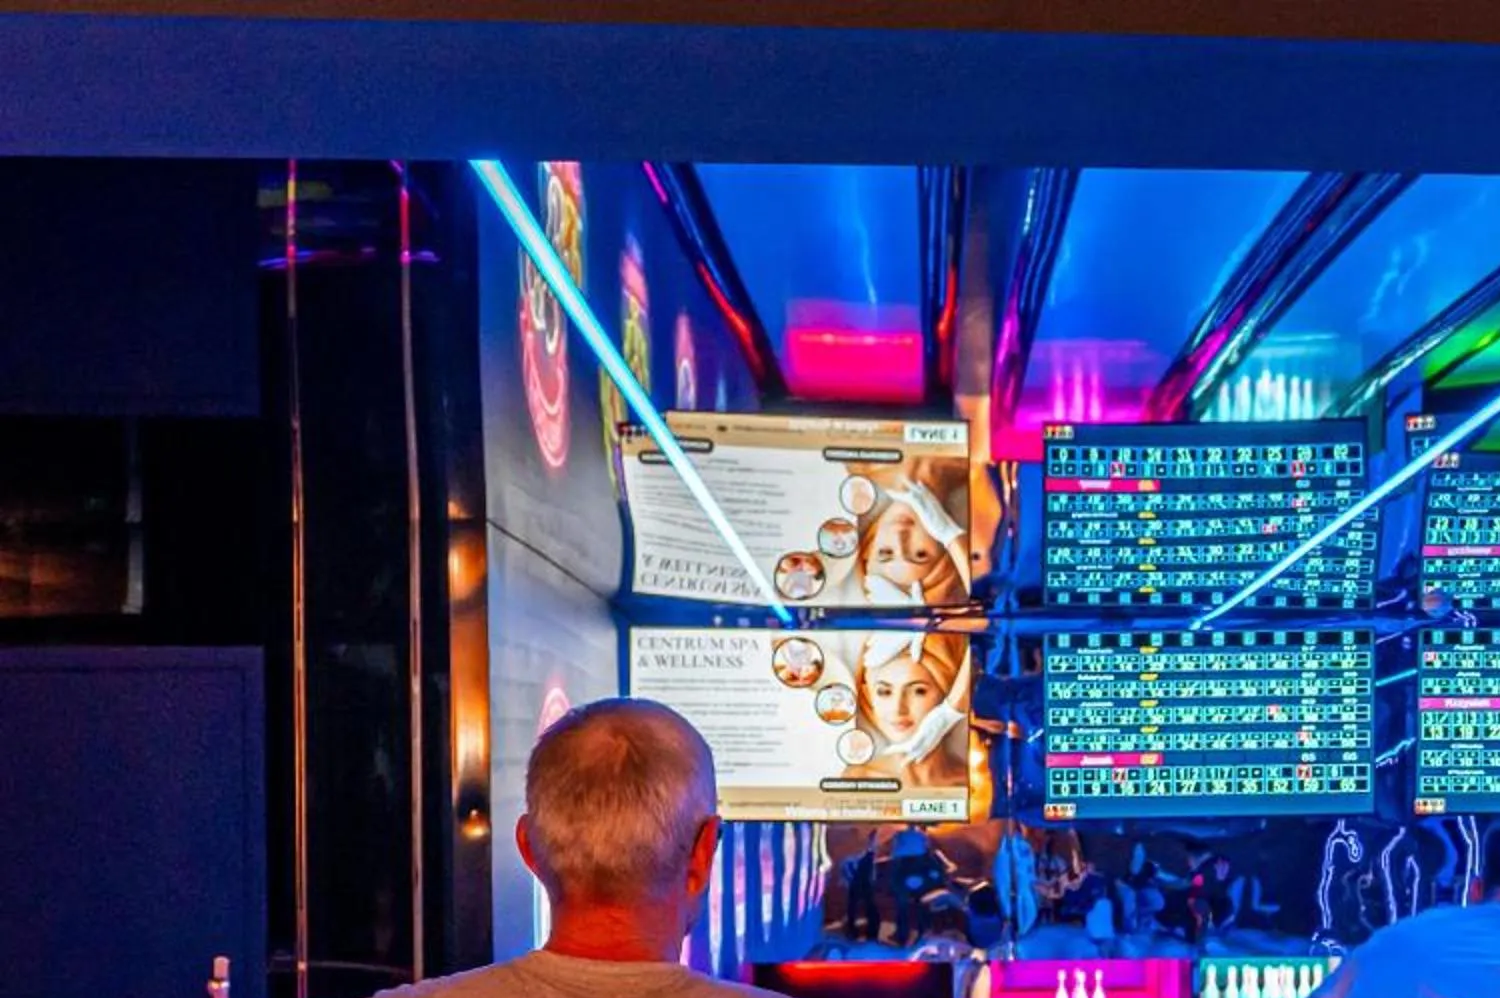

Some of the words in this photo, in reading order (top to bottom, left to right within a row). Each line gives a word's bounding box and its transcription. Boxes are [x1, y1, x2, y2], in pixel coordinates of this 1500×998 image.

[637, 636, 724, 650] CENTRUM
[729, 637, 759, 650] SPA
[637, 655, 649, 668] &
[654, 654, 744, 668] WELLNESS
[909, 802, 946, 814] LANE
[951, 802, 959, 814] 1
